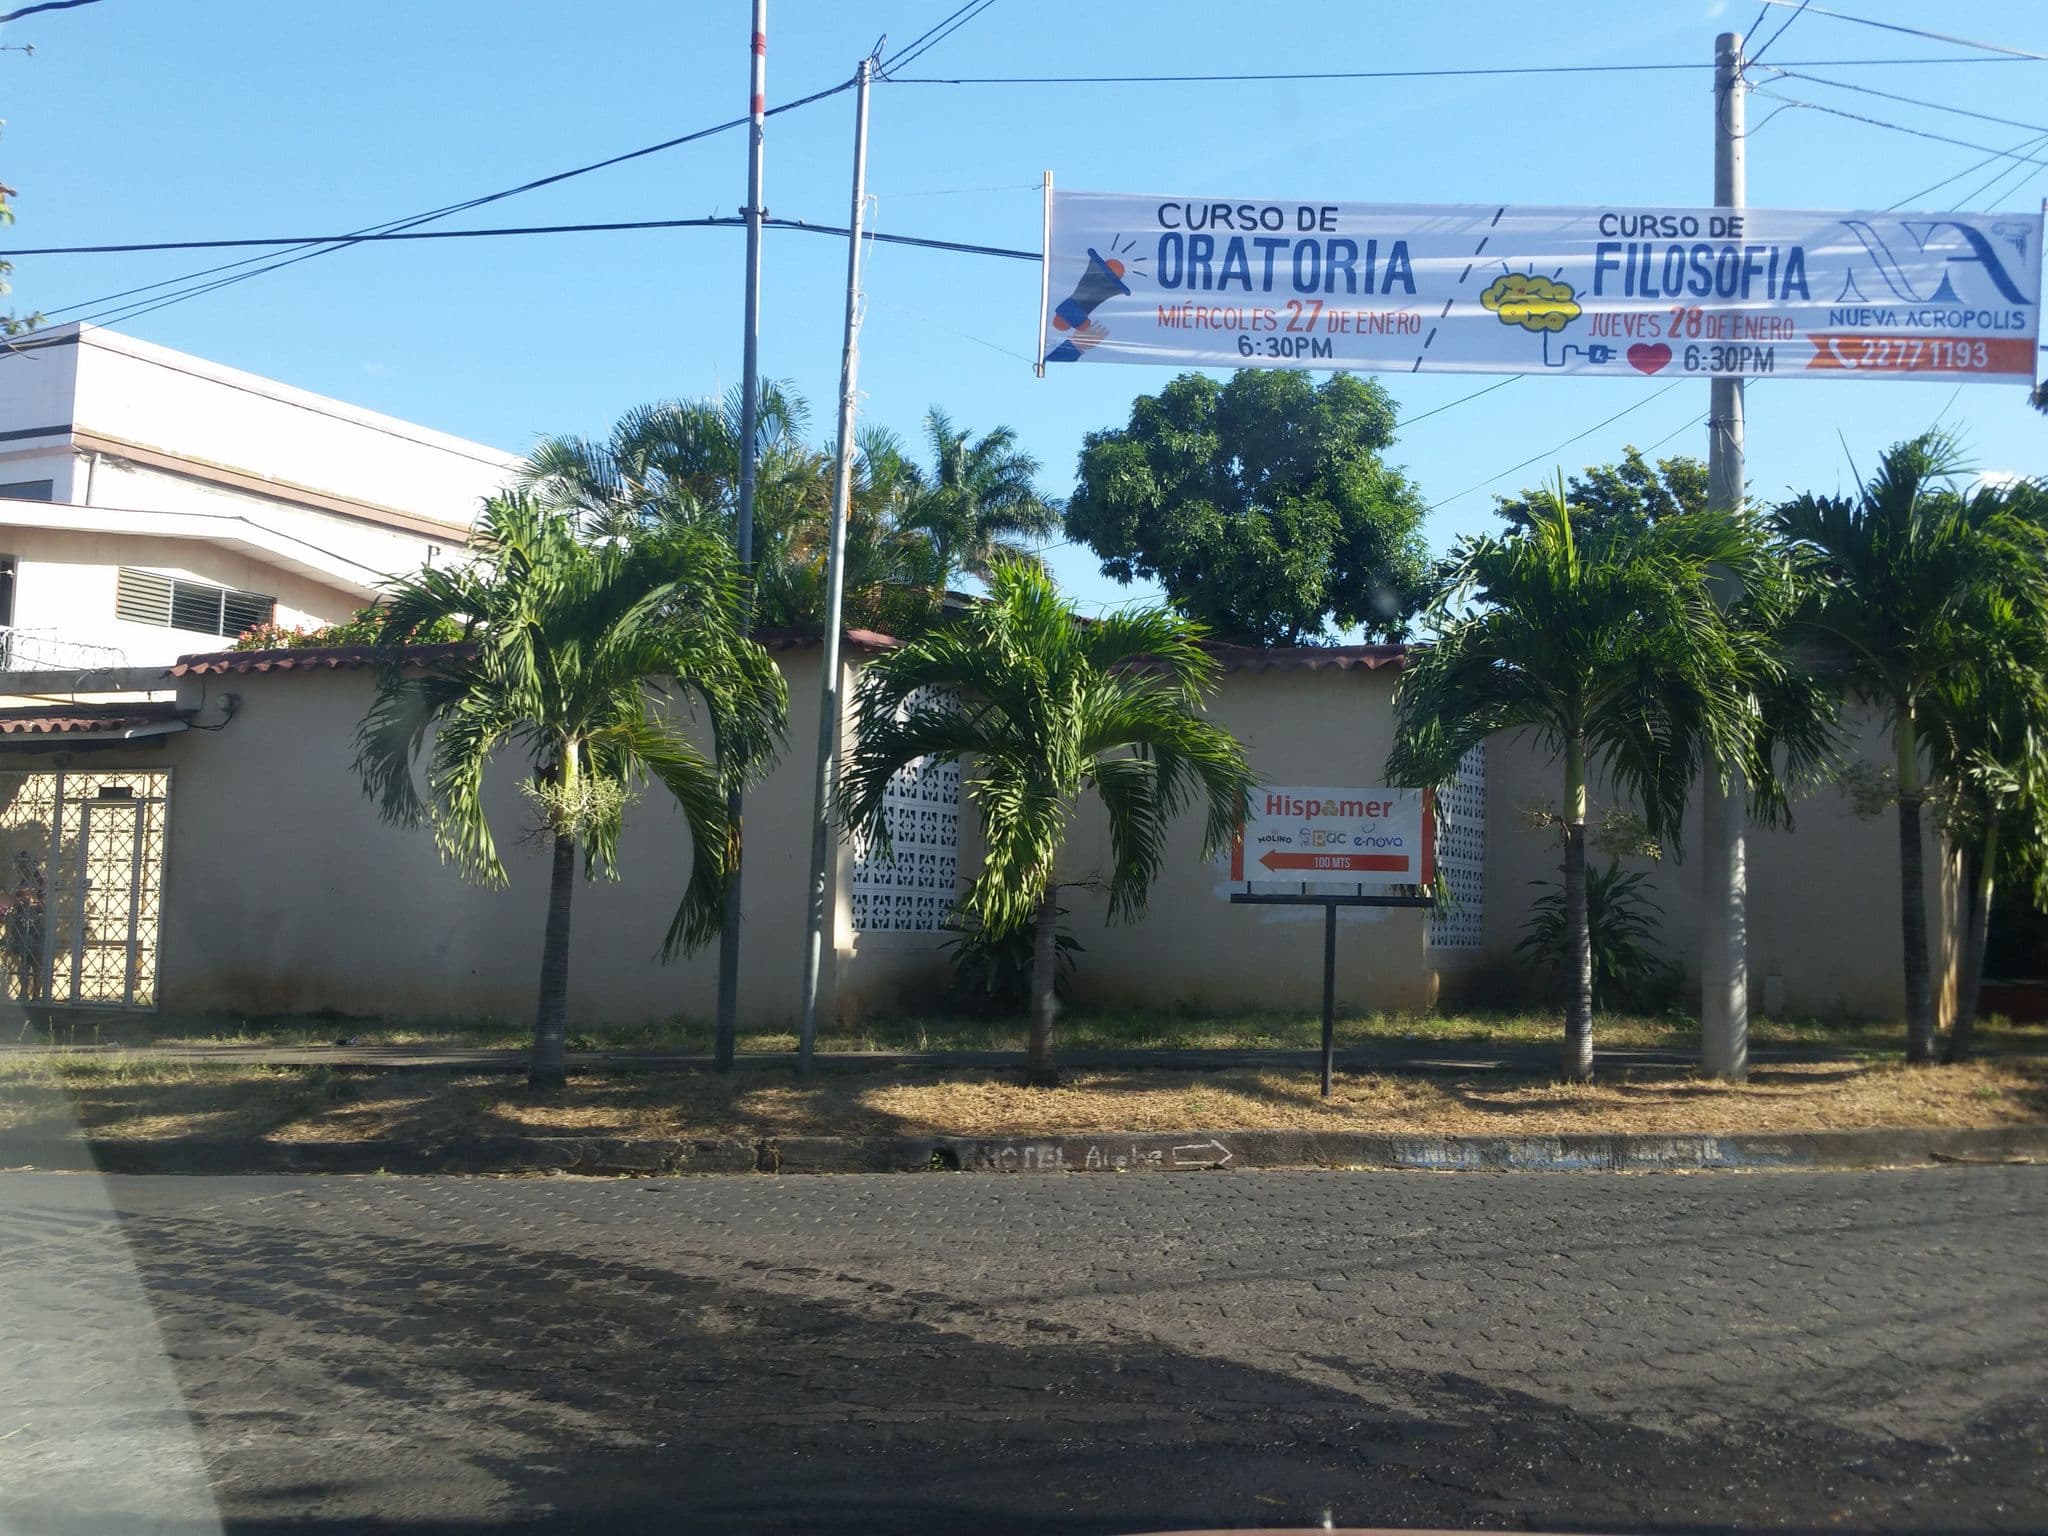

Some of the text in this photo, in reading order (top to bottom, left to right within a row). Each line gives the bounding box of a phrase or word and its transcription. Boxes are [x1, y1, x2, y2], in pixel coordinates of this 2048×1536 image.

[1158, 203, 1339, 232] CURSO DE
[1599, 214, 1744, 239] CURSO DE
[1157, 232, 1417, 295] ORATORIA
[1594, 242, 1811, 301] FILOSOFIA
[1157, 300, 1421, 336] MIÉRCOLES 27 DE ENERO
[1589, 306, 1794, 341] JUEVES 28 DE ENERO
[1829, 309, 2026, 330] NUEVA ACROPOLIS
[1238, 336, 1333, 360] 6:30PM
[1683, 345, 1775, 373] 6:30PM
[1257, 834, 1293, 845] MOLINO
[1314, 857, 1351, 869] 100 MTS
